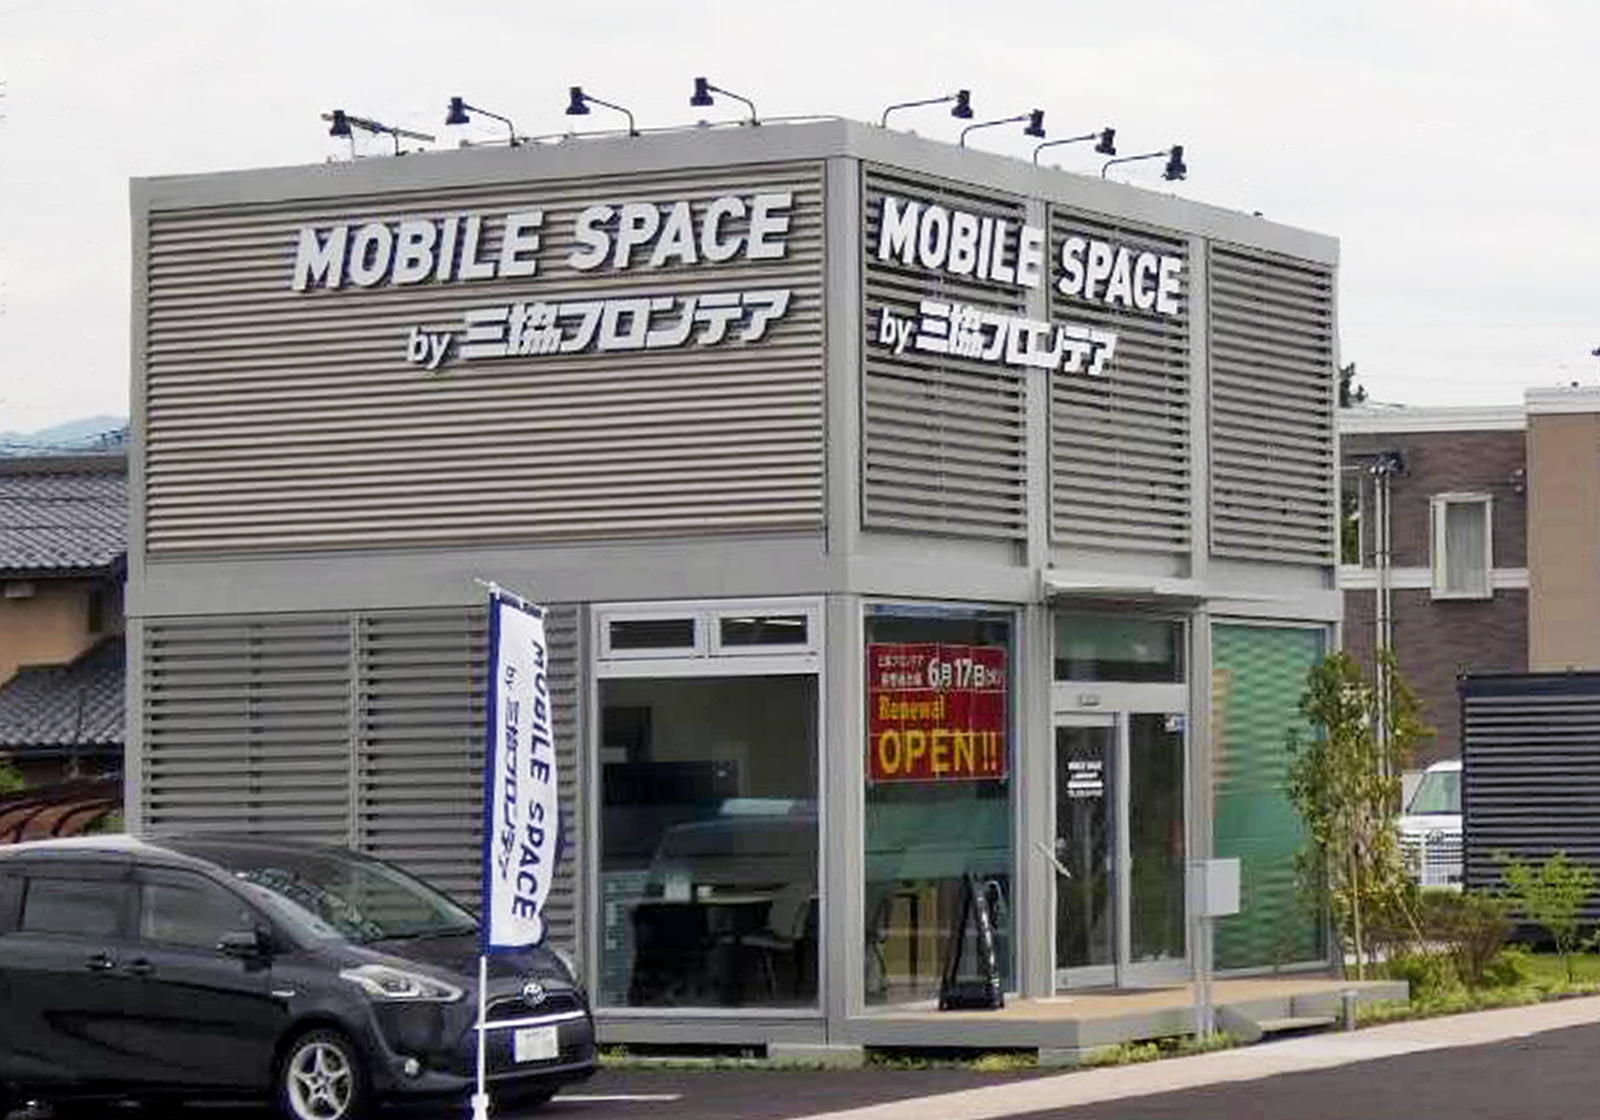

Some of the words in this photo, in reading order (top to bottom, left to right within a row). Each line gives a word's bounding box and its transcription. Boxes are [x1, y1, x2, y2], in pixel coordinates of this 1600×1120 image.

[292, 209, 544, 291] MOBILE
[567, 192, 792, 271] SPACE
[877, 197, 1046, 287] MOBILE
[1059, 236, 1182, 315] SPACE
[406, 326, 453, 369] by
[459, 290, 791, 359] 三協フロンテア
[879, 307, 913, 354] by
[915, 300, 1118, 377] 三協フロンテア
[530, 641, 551, 784] MOBILE
[879, 694, 945, 719] Renewal
[512, 801, 545, 919] SPACE
